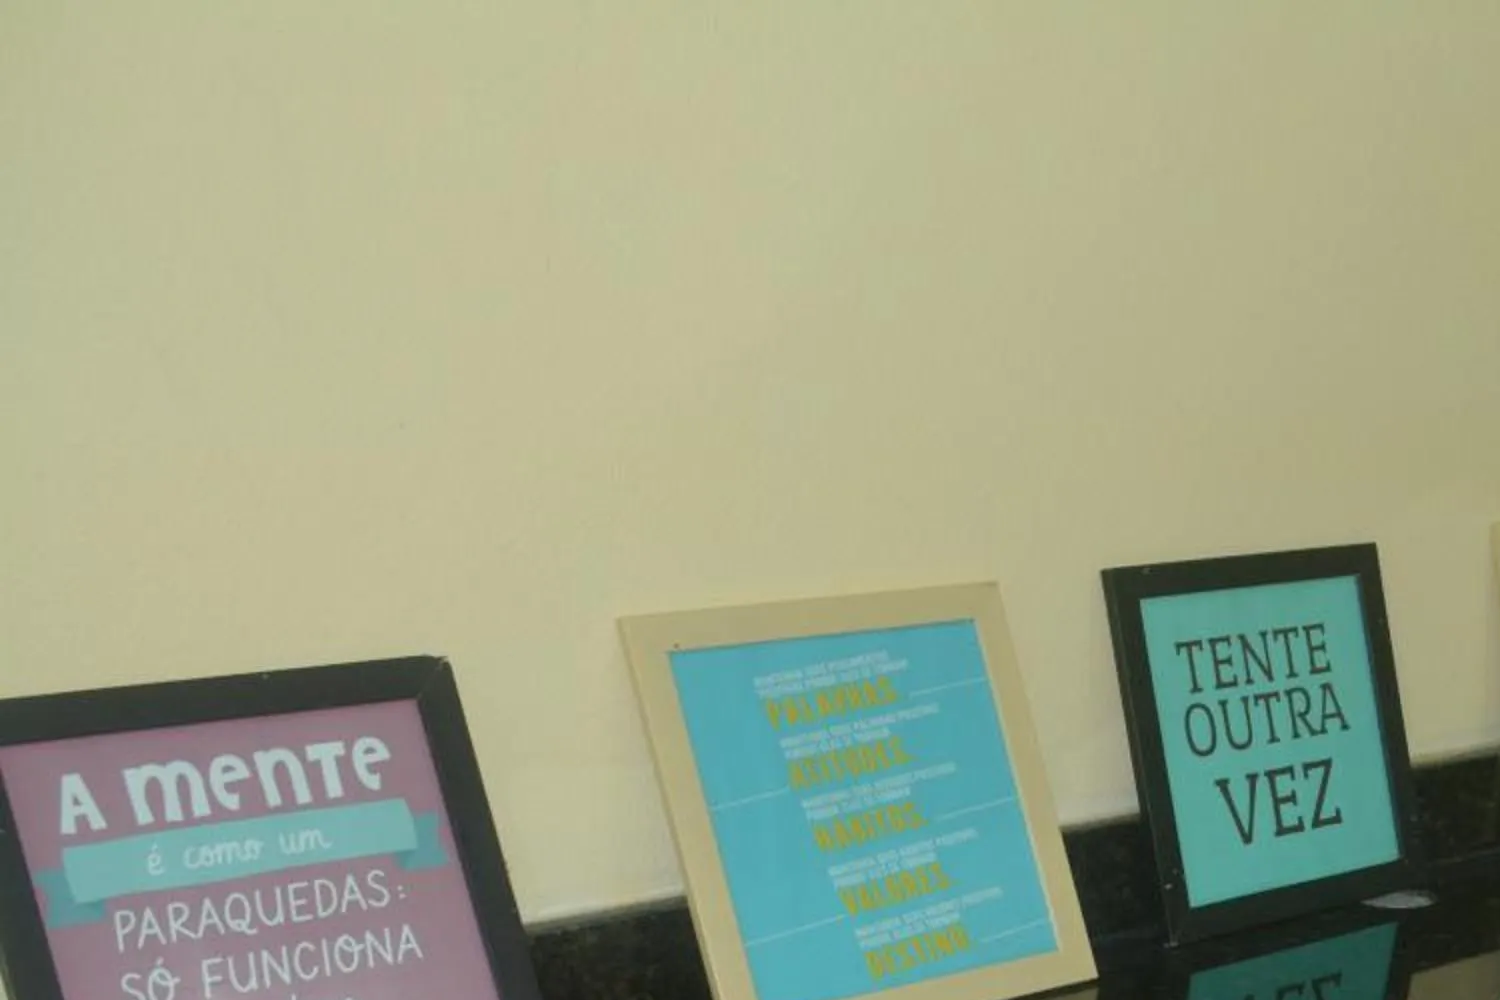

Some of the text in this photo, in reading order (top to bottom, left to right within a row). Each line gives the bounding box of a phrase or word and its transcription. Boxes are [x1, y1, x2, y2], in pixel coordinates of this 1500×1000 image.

[1174, 623, 1332, 695] TENTE
[1184, 682, 1351, 757] OUTRA
[59, 772, 108, 835] A
[1213, 757, 1343, 845] VEZ
[146, 827, 333, 876] é como um
[113, 870, 408, 953] PARAQUEDAS:
[201, 925, 424, 1000] FUNCIONA
